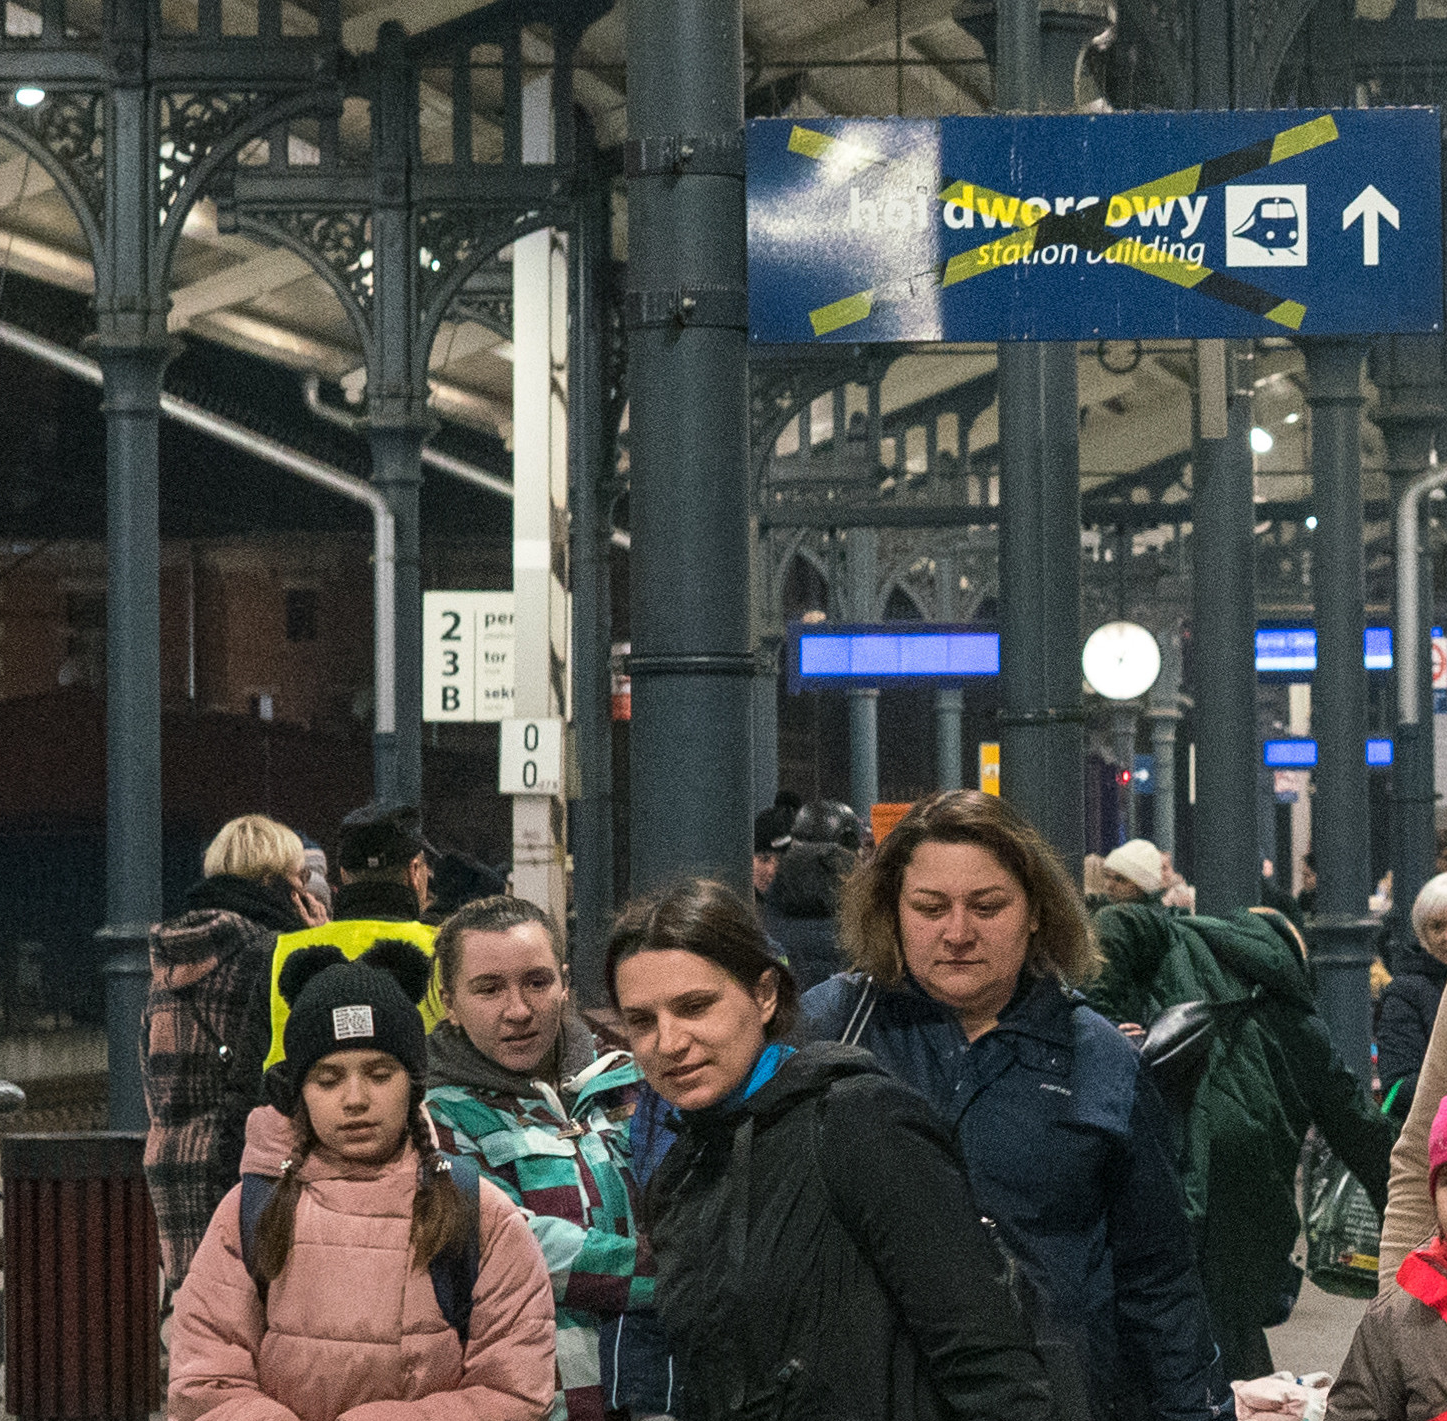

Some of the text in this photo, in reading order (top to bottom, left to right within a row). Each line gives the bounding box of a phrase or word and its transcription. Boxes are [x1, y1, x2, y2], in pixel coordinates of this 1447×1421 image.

[440, 611, 514, 641] 2 per
[442, 650, 506, 677] 3 tor
[441, 685, 461, 712] B
[524, 723, 539, 752] 0
[522, 760, 538, 789] 0
